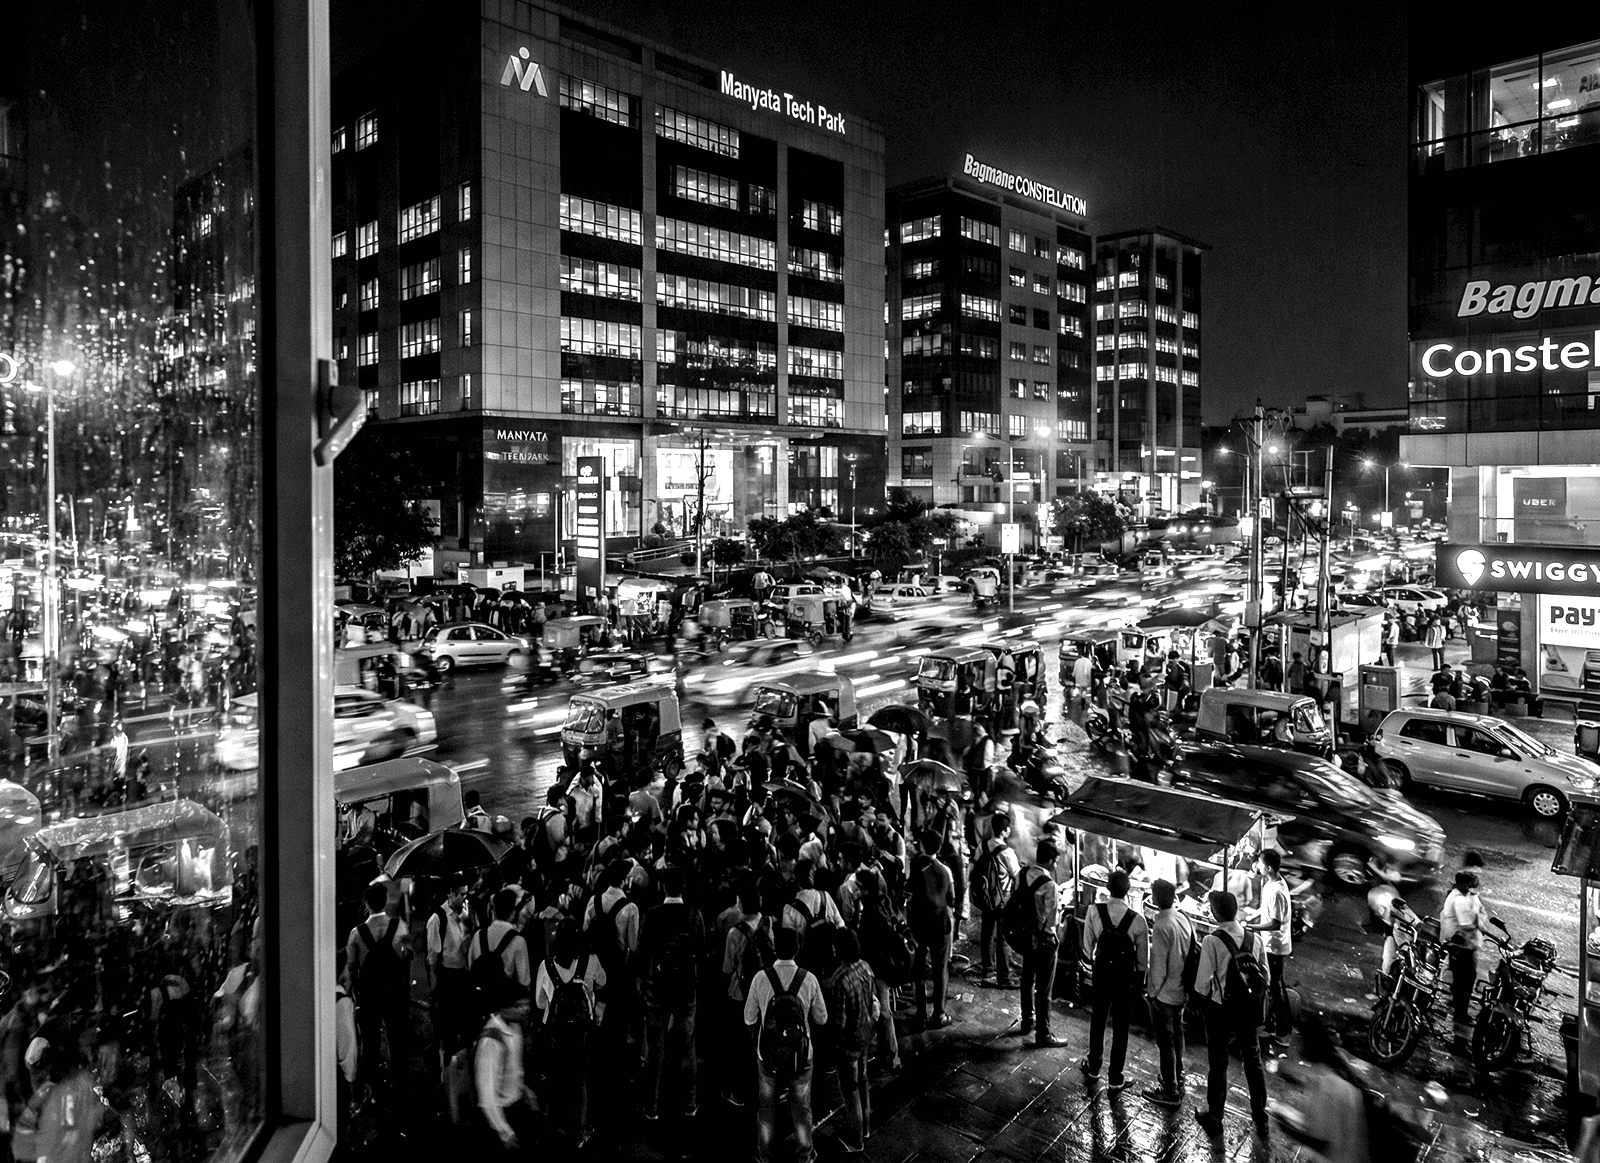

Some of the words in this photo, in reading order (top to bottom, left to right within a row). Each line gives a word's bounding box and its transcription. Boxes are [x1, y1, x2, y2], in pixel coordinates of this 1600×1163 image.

[721, 70, 781, 112] Manyata
[783, 92, 815, 124] Tech
[818, 105, 846, 135] Park
[963, 153, 1015, 190] Bagmane
[1015, 175, 1087, 217] CONSTELLATION
[497, 429, 549, 442] MANYATA
[1522, 498, 1556, 507] UBER
